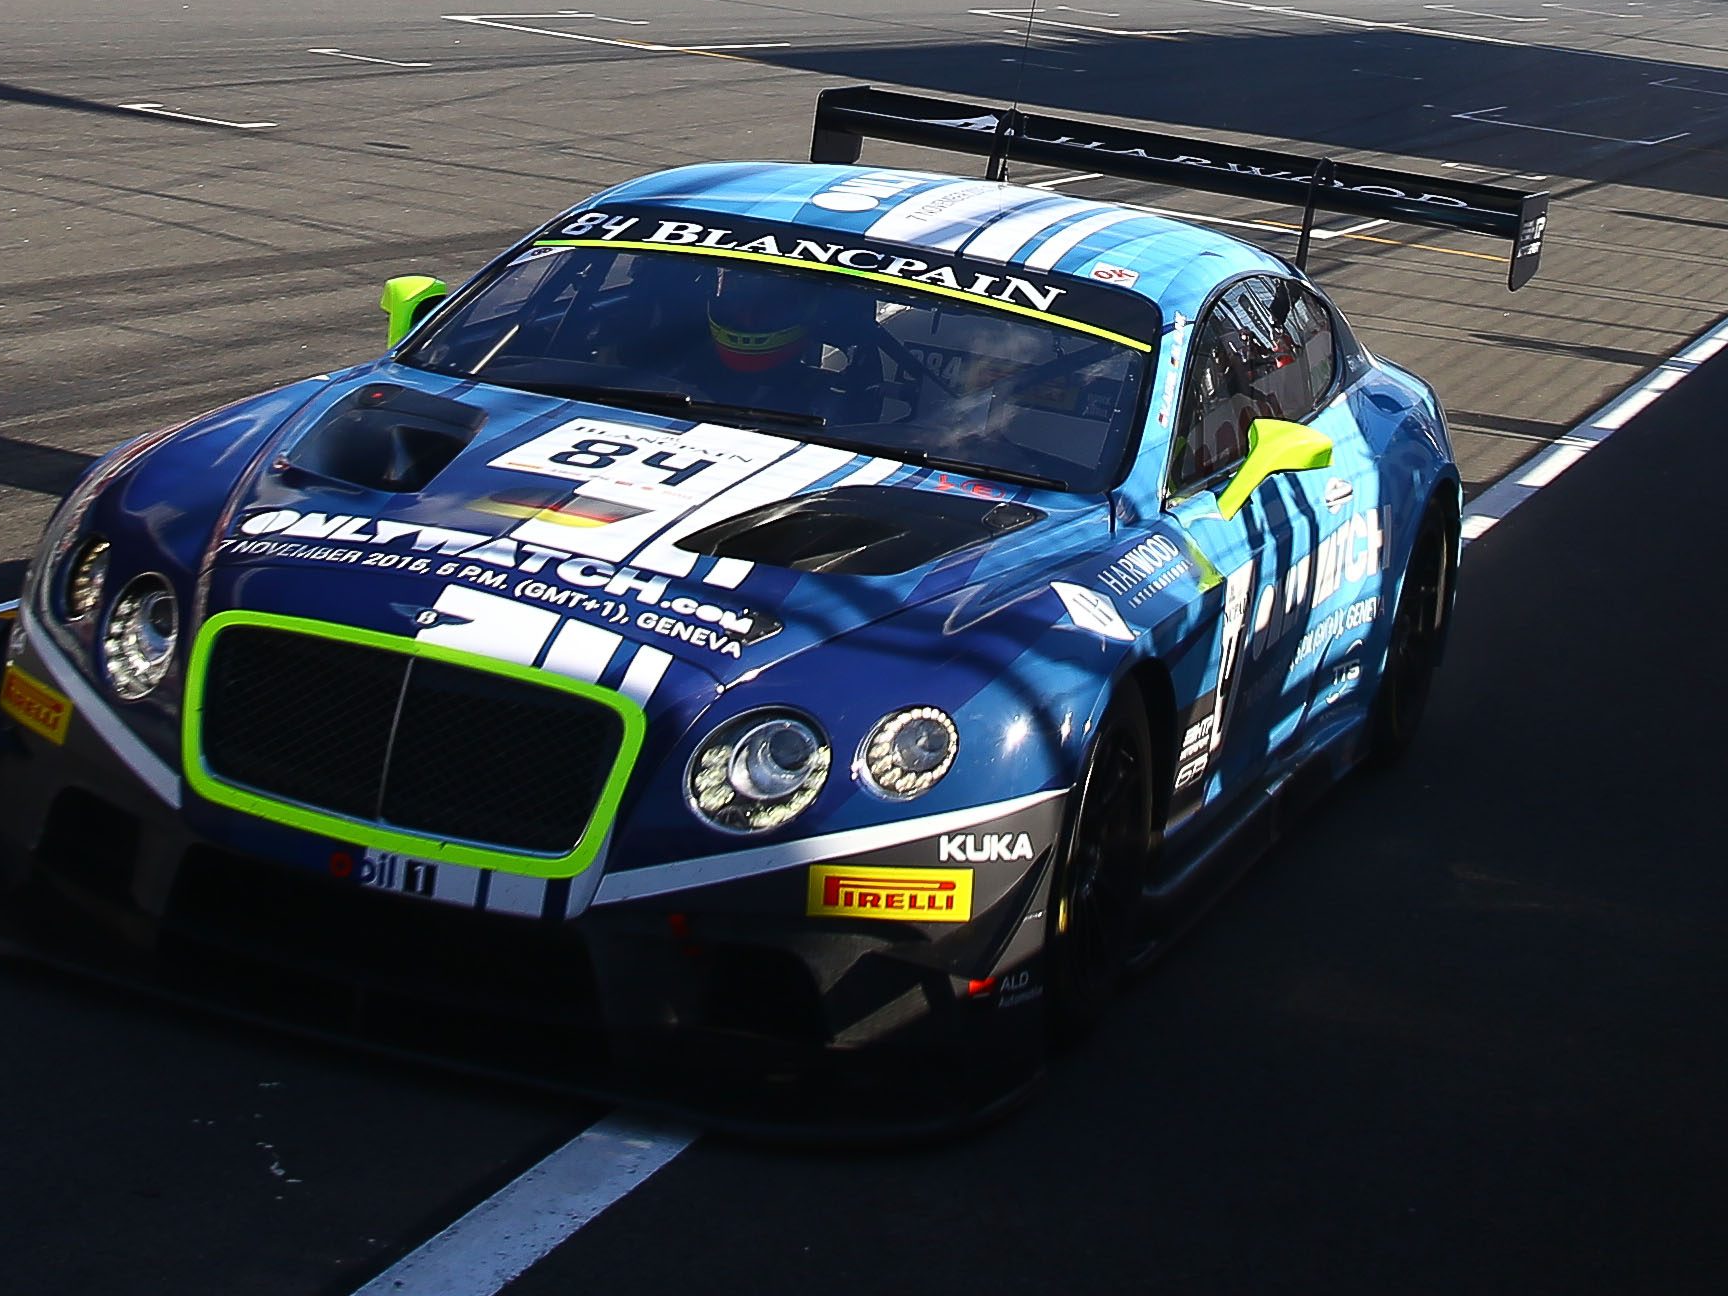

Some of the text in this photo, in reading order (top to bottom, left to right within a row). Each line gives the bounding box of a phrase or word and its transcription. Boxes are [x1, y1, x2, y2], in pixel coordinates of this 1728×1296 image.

[561, 212, 1067, 312] 84 BLANCPAIN
[549, 439, 717, 487] 84
[1097, 533, 1180, 596] HARWOOD
[234, 540, 365, 564] NOVEMBER
[636, 611, 742, 660] GENEVA
[938, 833, 1033, 862] KUKA
[823, 875, 956, 910] PIRELLI
